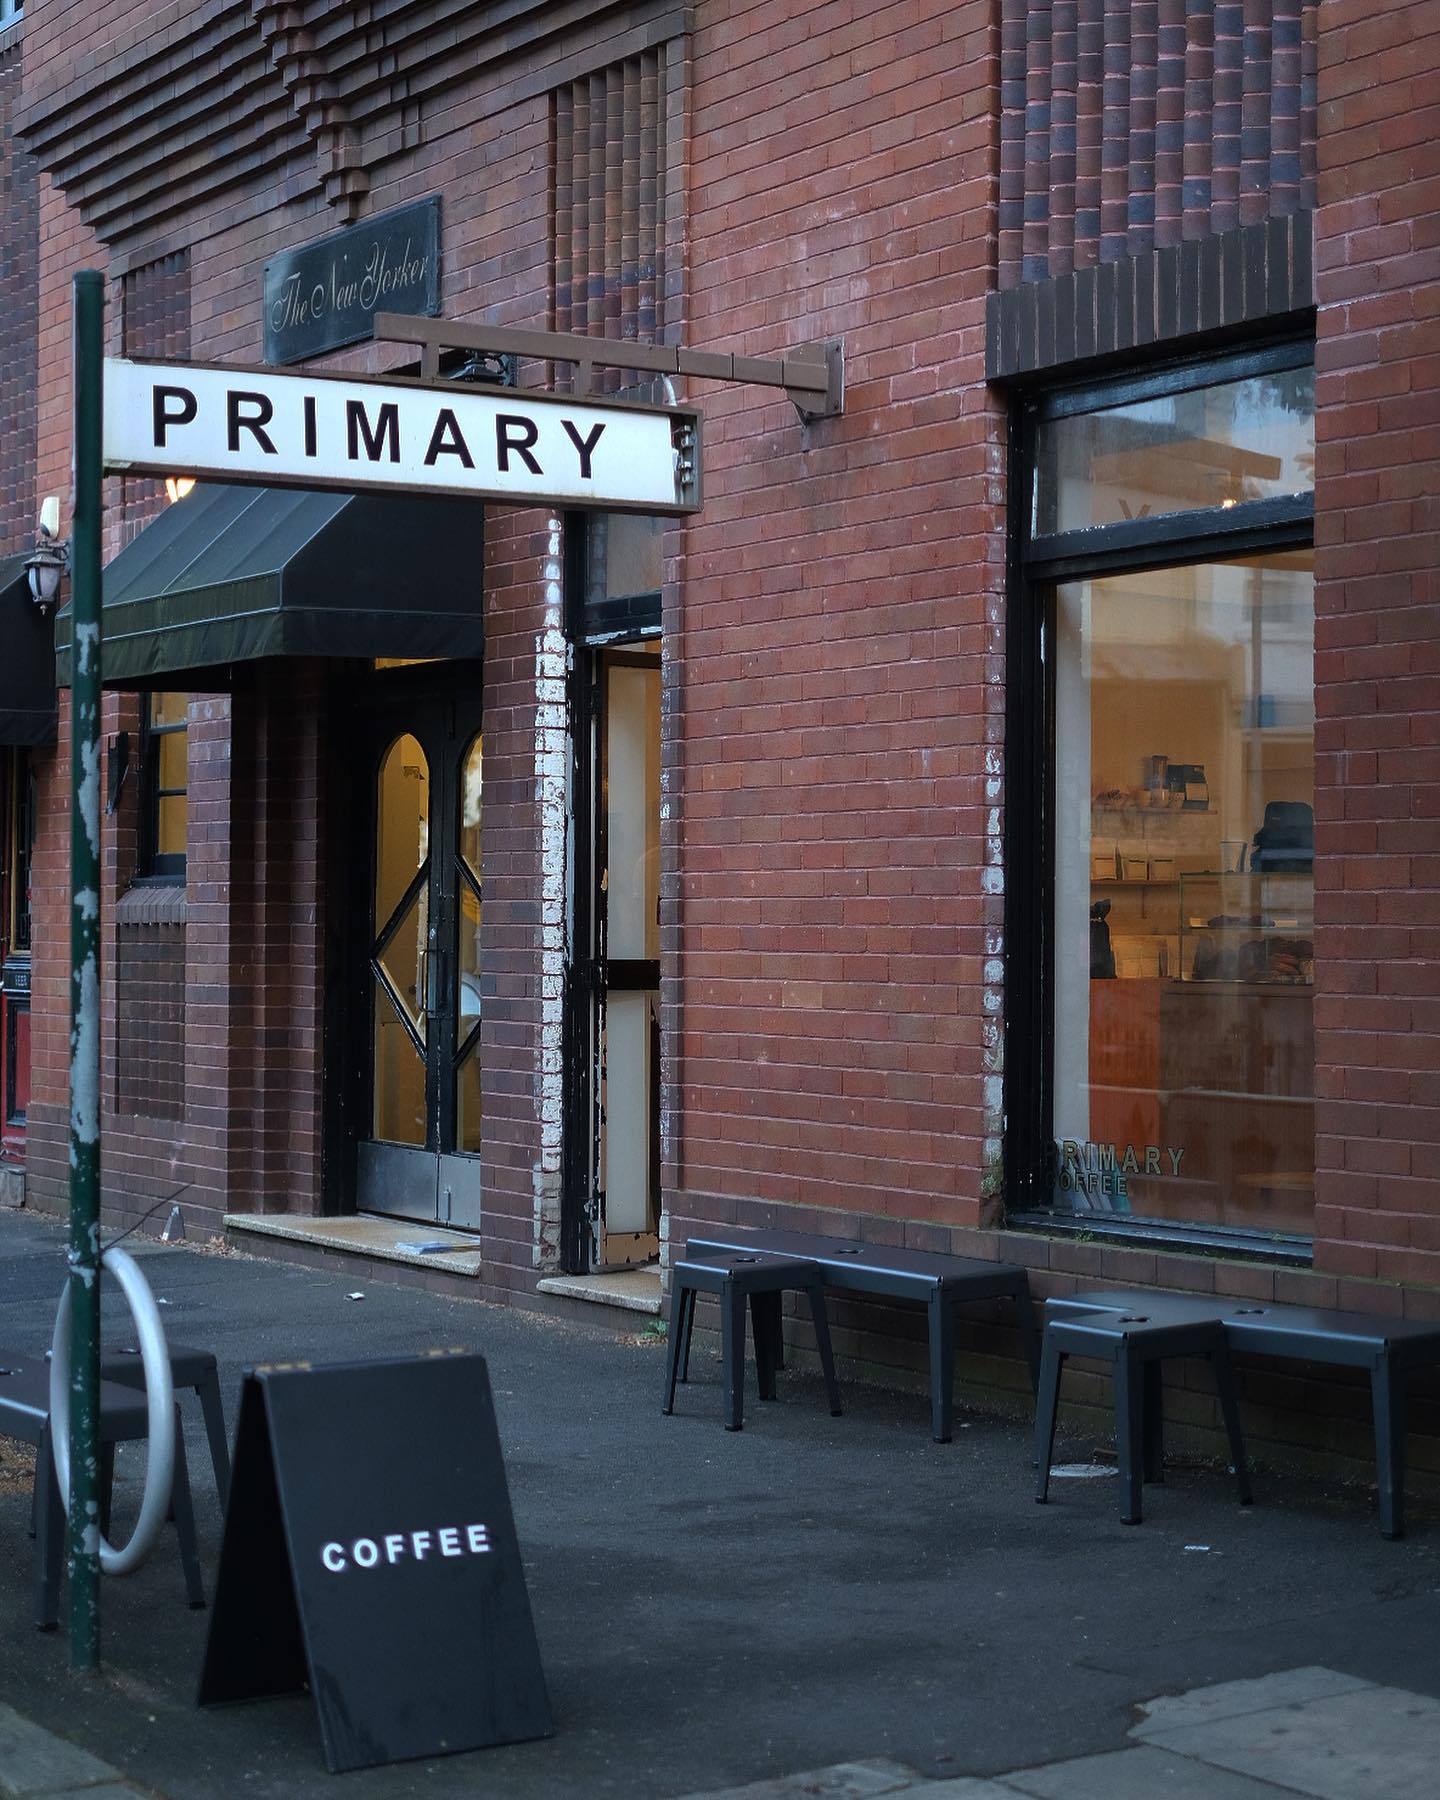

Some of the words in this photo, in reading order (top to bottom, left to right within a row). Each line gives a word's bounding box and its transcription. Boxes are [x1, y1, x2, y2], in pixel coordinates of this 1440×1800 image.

[272, 272, 308, 333] The
[311, 256, 357, 319] New
[360, 238, 430, 310] Yorker
[153, 385, 605, 478] PRIMARY
[322, 1524, 491, 1572] COFFEE
